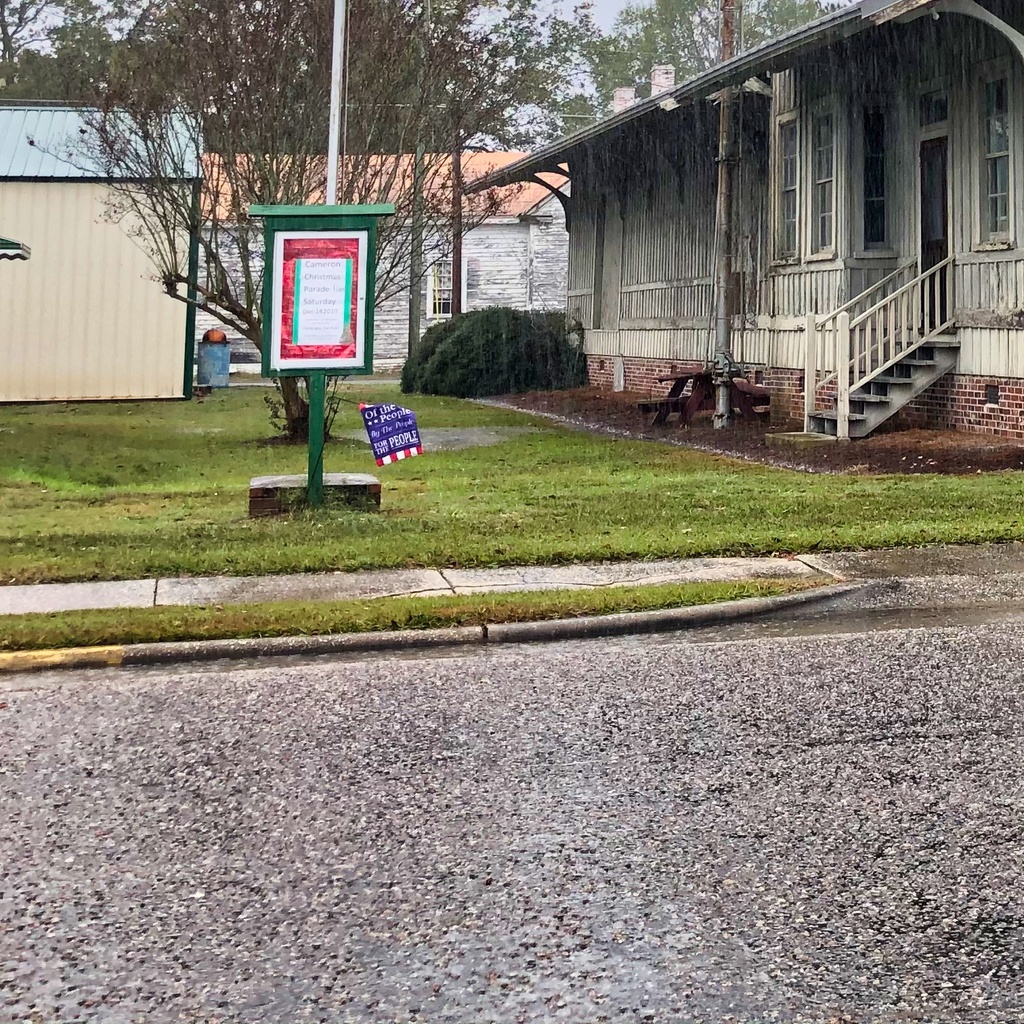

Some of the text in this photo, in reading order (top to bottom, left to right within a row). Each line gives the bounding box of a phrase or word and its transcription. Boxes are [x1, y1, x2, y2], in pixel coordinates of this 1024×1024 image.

[305, 260, 341, 268] Cameron
[304, 273, 341, 281] Christmas
[303, 285, 330, 293] Parade
[303, 298, 336, 306] Saturday
[365, 404, 396, 419] Of the
[380, 407, 412, 423] People
[388, 430, 419, 448] PEOPLE
[373, 439, 388, 449] FOR
[375, 446, 390, 455] THE
